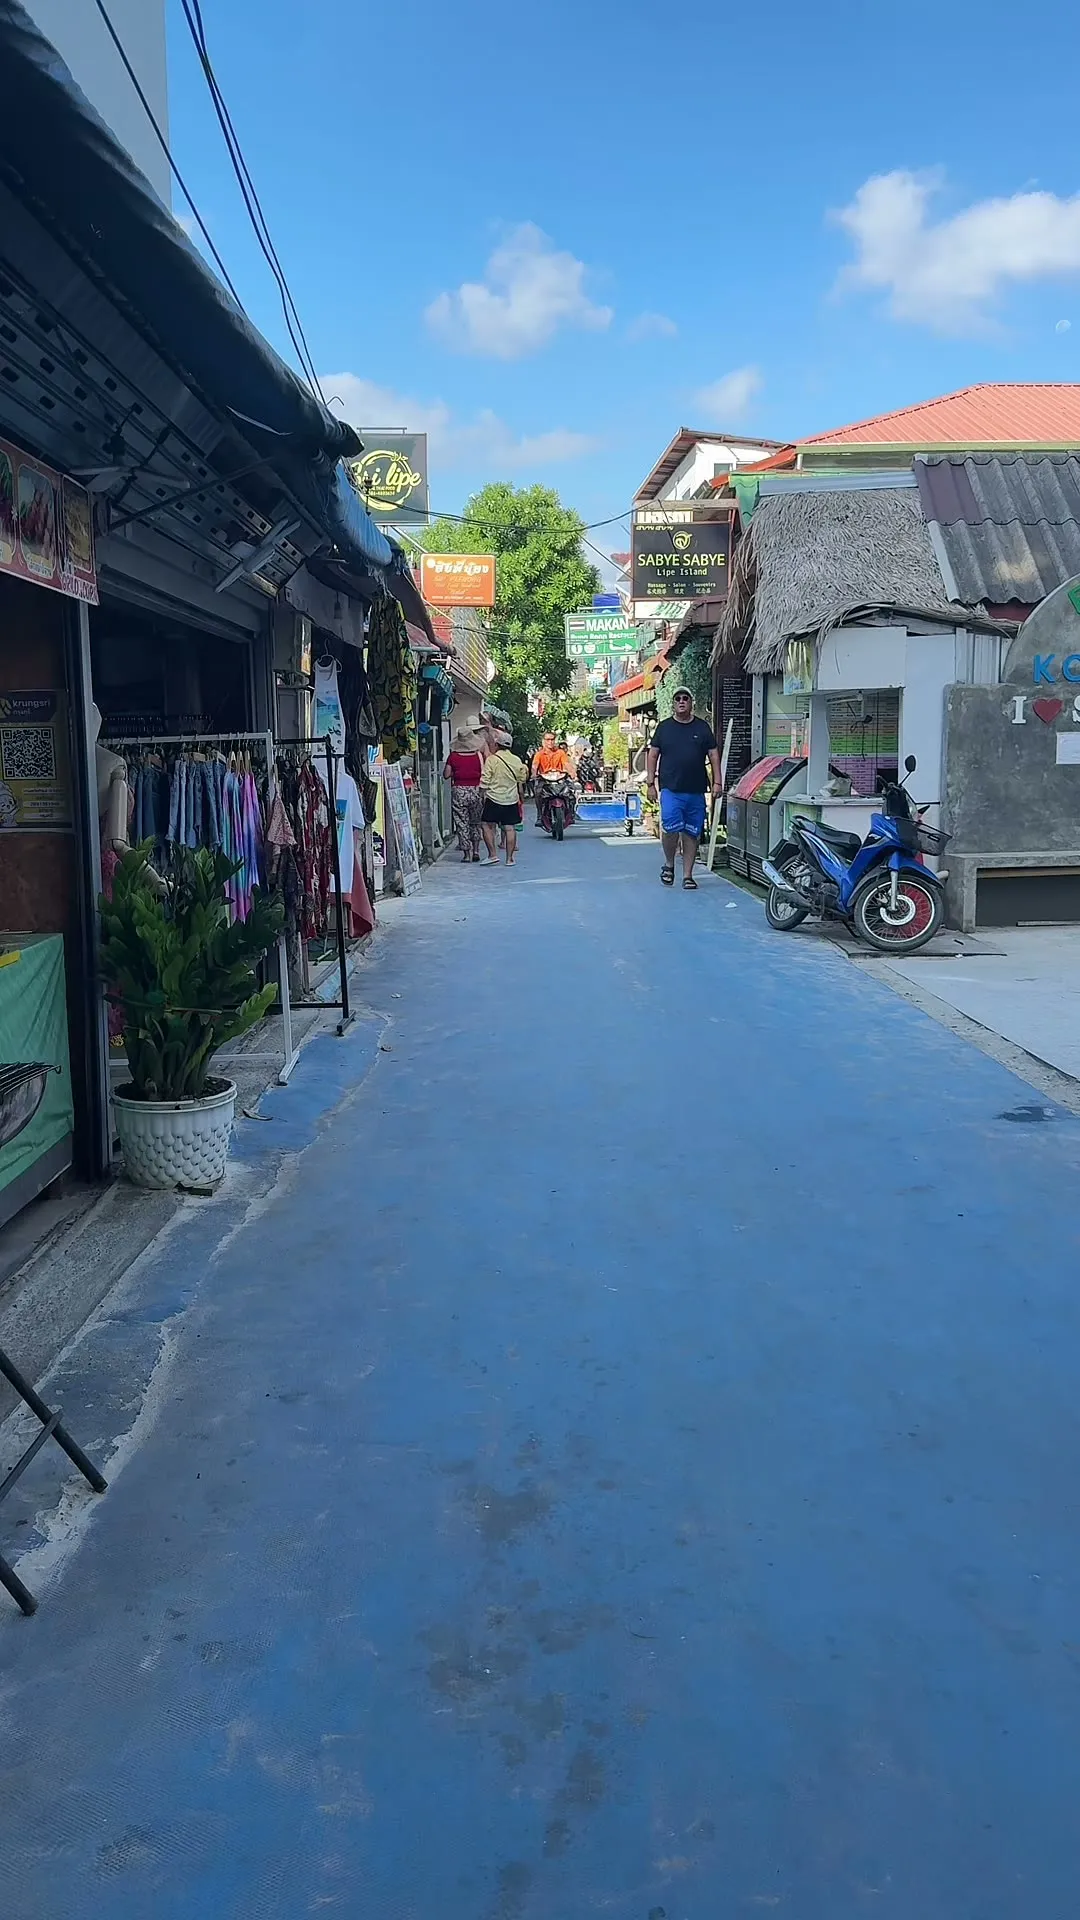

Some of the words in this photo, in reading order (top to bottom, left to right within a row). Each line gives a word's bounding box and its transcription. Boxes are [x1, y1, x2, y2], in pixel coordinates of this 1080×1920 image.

[385, 461, 422, 493] lipe
[637, 553, 680, 567] SABYE
[682, 553, 726, 567] SABYE
[656, 568, 676, 577] Lipe
[680, 567, 708, 576] Island
[586, 618, 629, 631] MAKAN
[12, 699, 50, 708] krungsri
[1011, 695, 1028, 725] I
